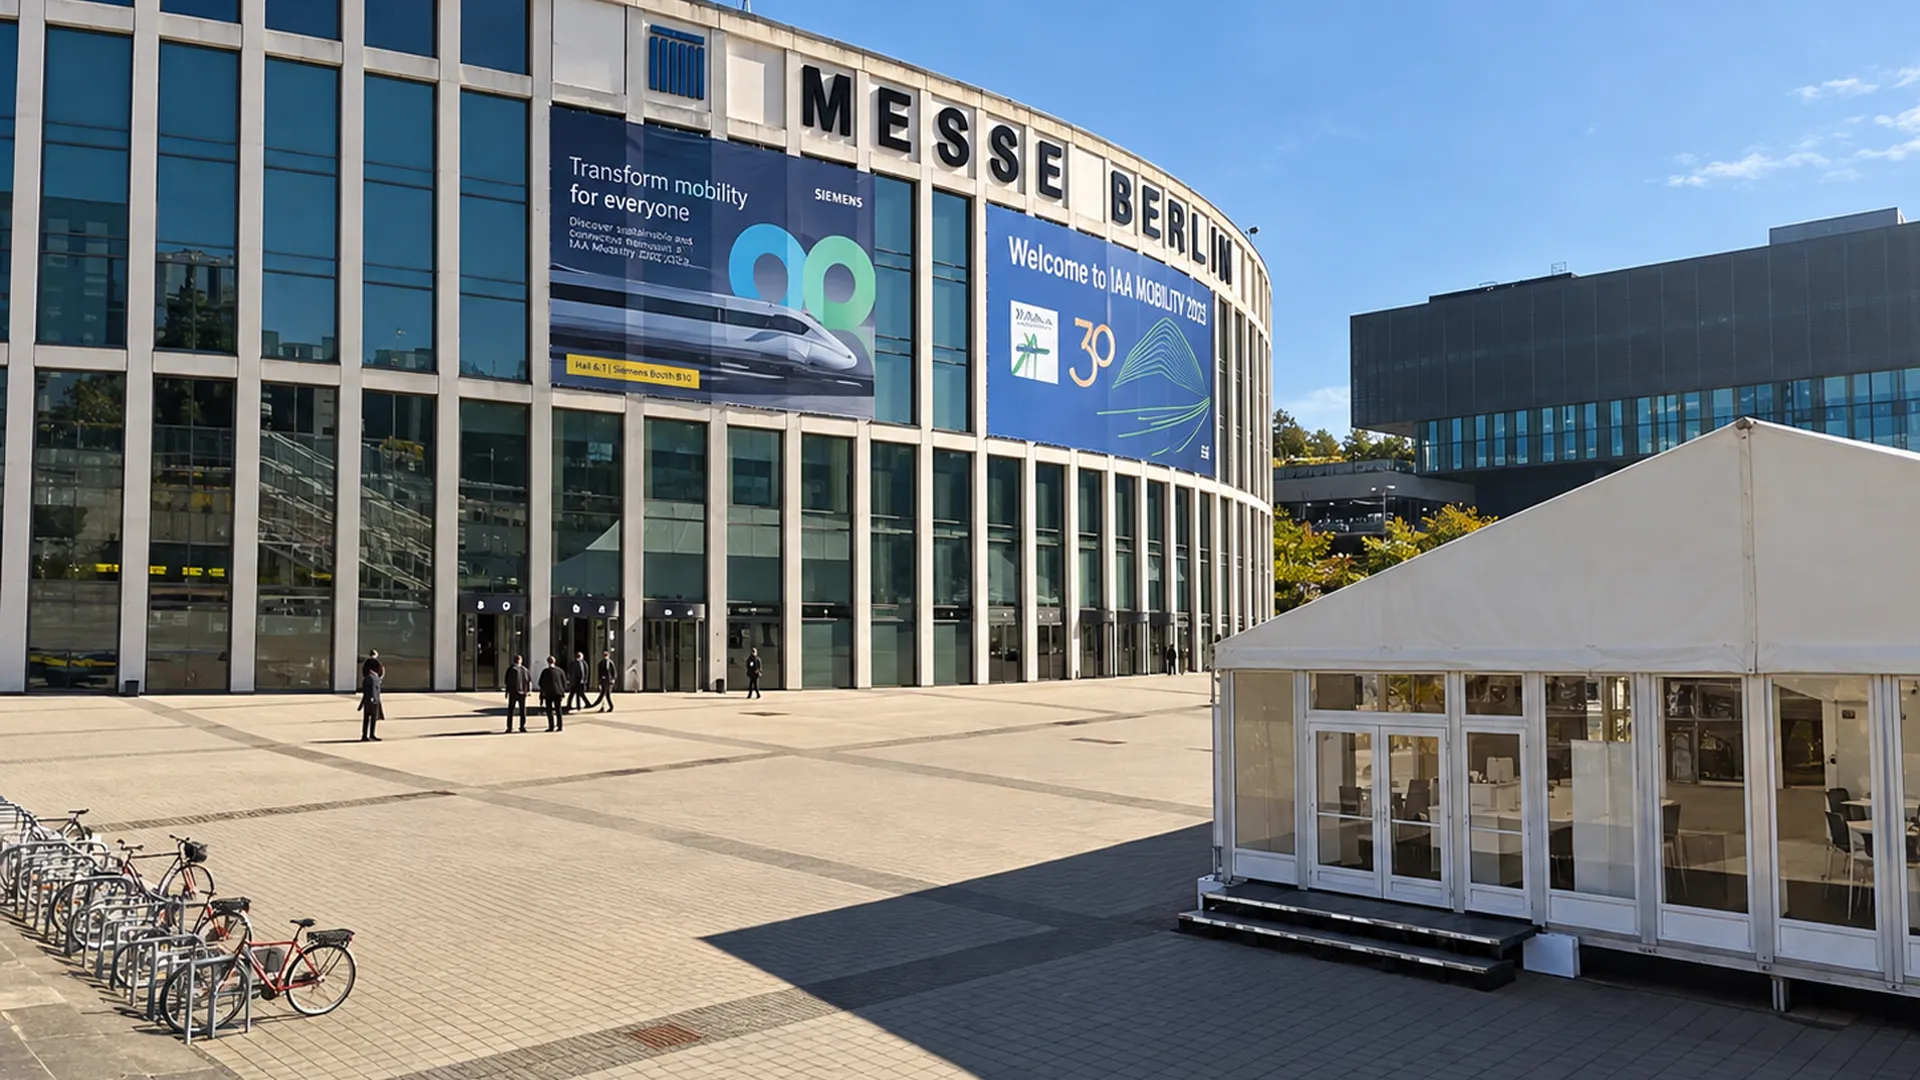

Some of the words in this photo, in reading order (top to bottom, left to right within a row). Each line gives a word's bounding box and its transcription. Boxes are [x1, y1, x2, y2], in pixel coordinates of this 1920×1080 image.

[569, 156, 668, 192] Transform
[675, 179, 748, 211] mobility
[569, 184, 598, 206] for
[604, 192, 690, 222] everyone
[802, 64, 1063, 200] MESSE
[1110, 170, 1233, 285] BERLIN
[814, 187, 864, 208] SIEMENS
[1008, 235, 1088, 285] Welcome
[1092, 262, 1107, 289] to
[1110, 266, 1133, 298] IAA
[1136, 275, 1185, 317] MOBILITY
[1069, 316, 1116, 388] 30
